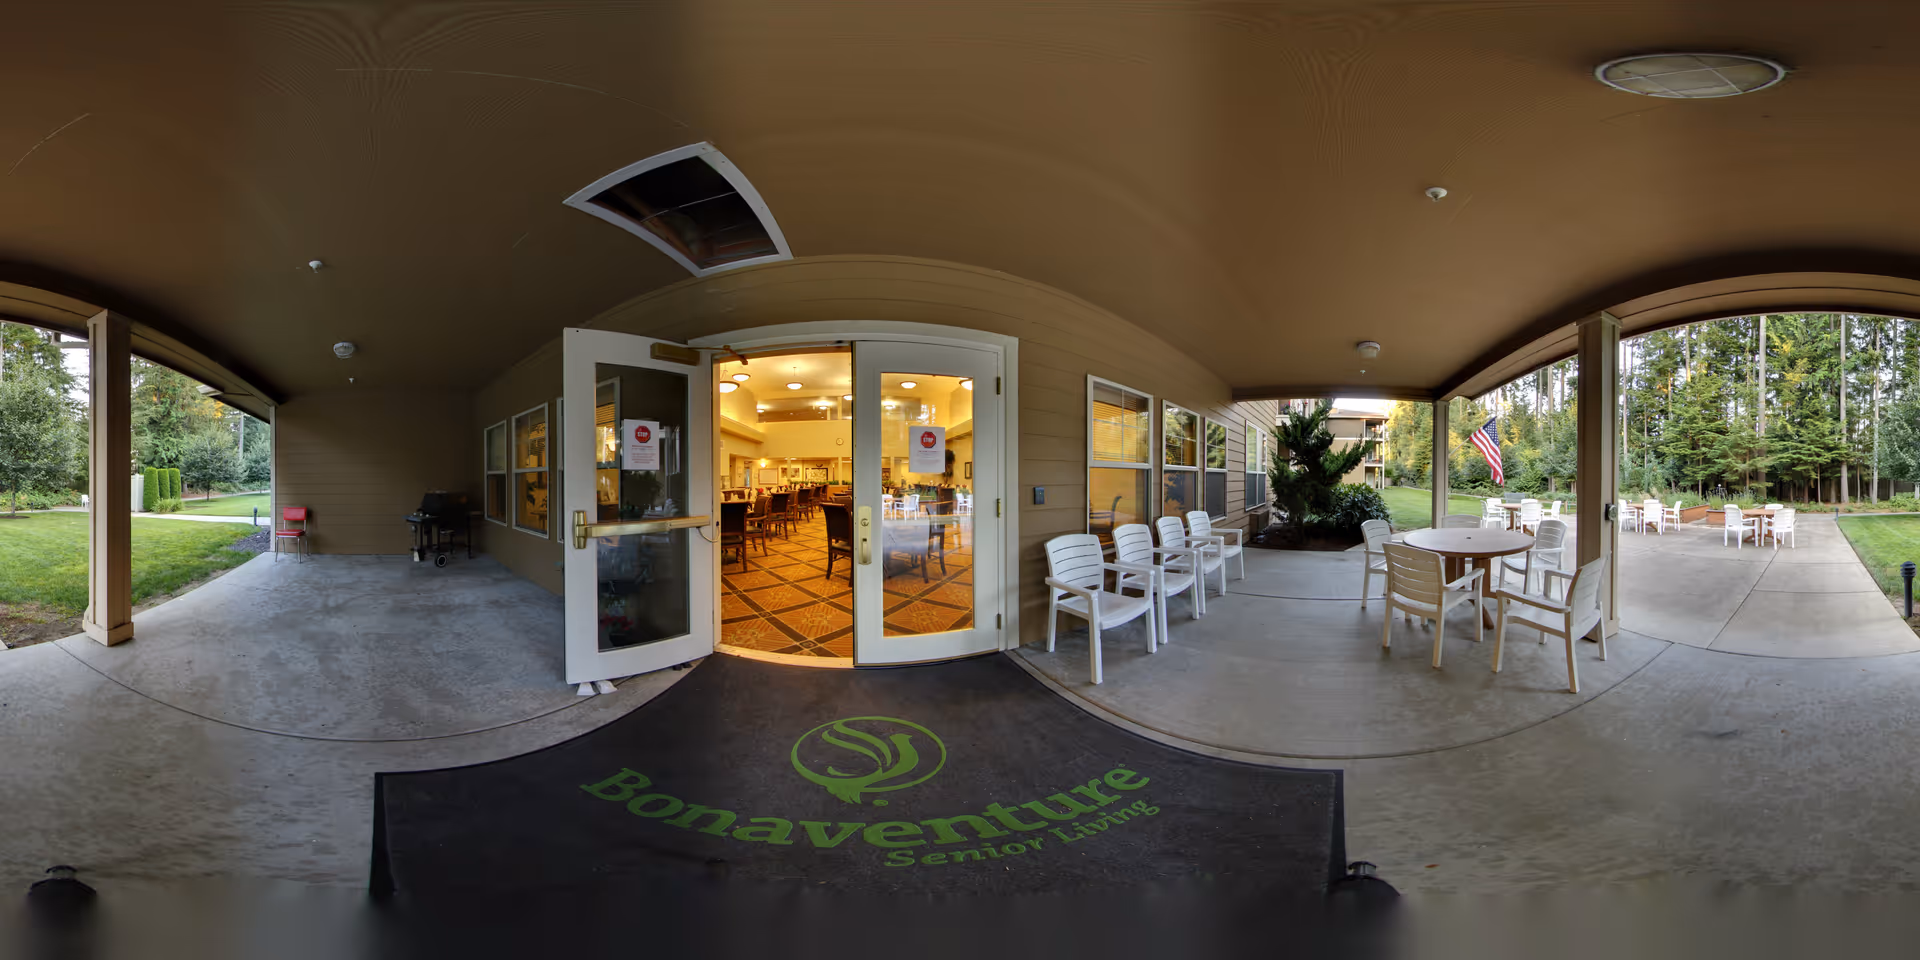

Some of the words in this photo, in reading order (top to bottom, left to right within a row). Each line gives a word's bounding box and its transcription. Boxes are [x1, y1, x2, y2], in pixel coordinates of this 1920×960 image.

[579, 767, 1150, 848] Bonaventure
[883, 837, 1044, 867] Senior
[1048, 799, 1160, 844] Living
